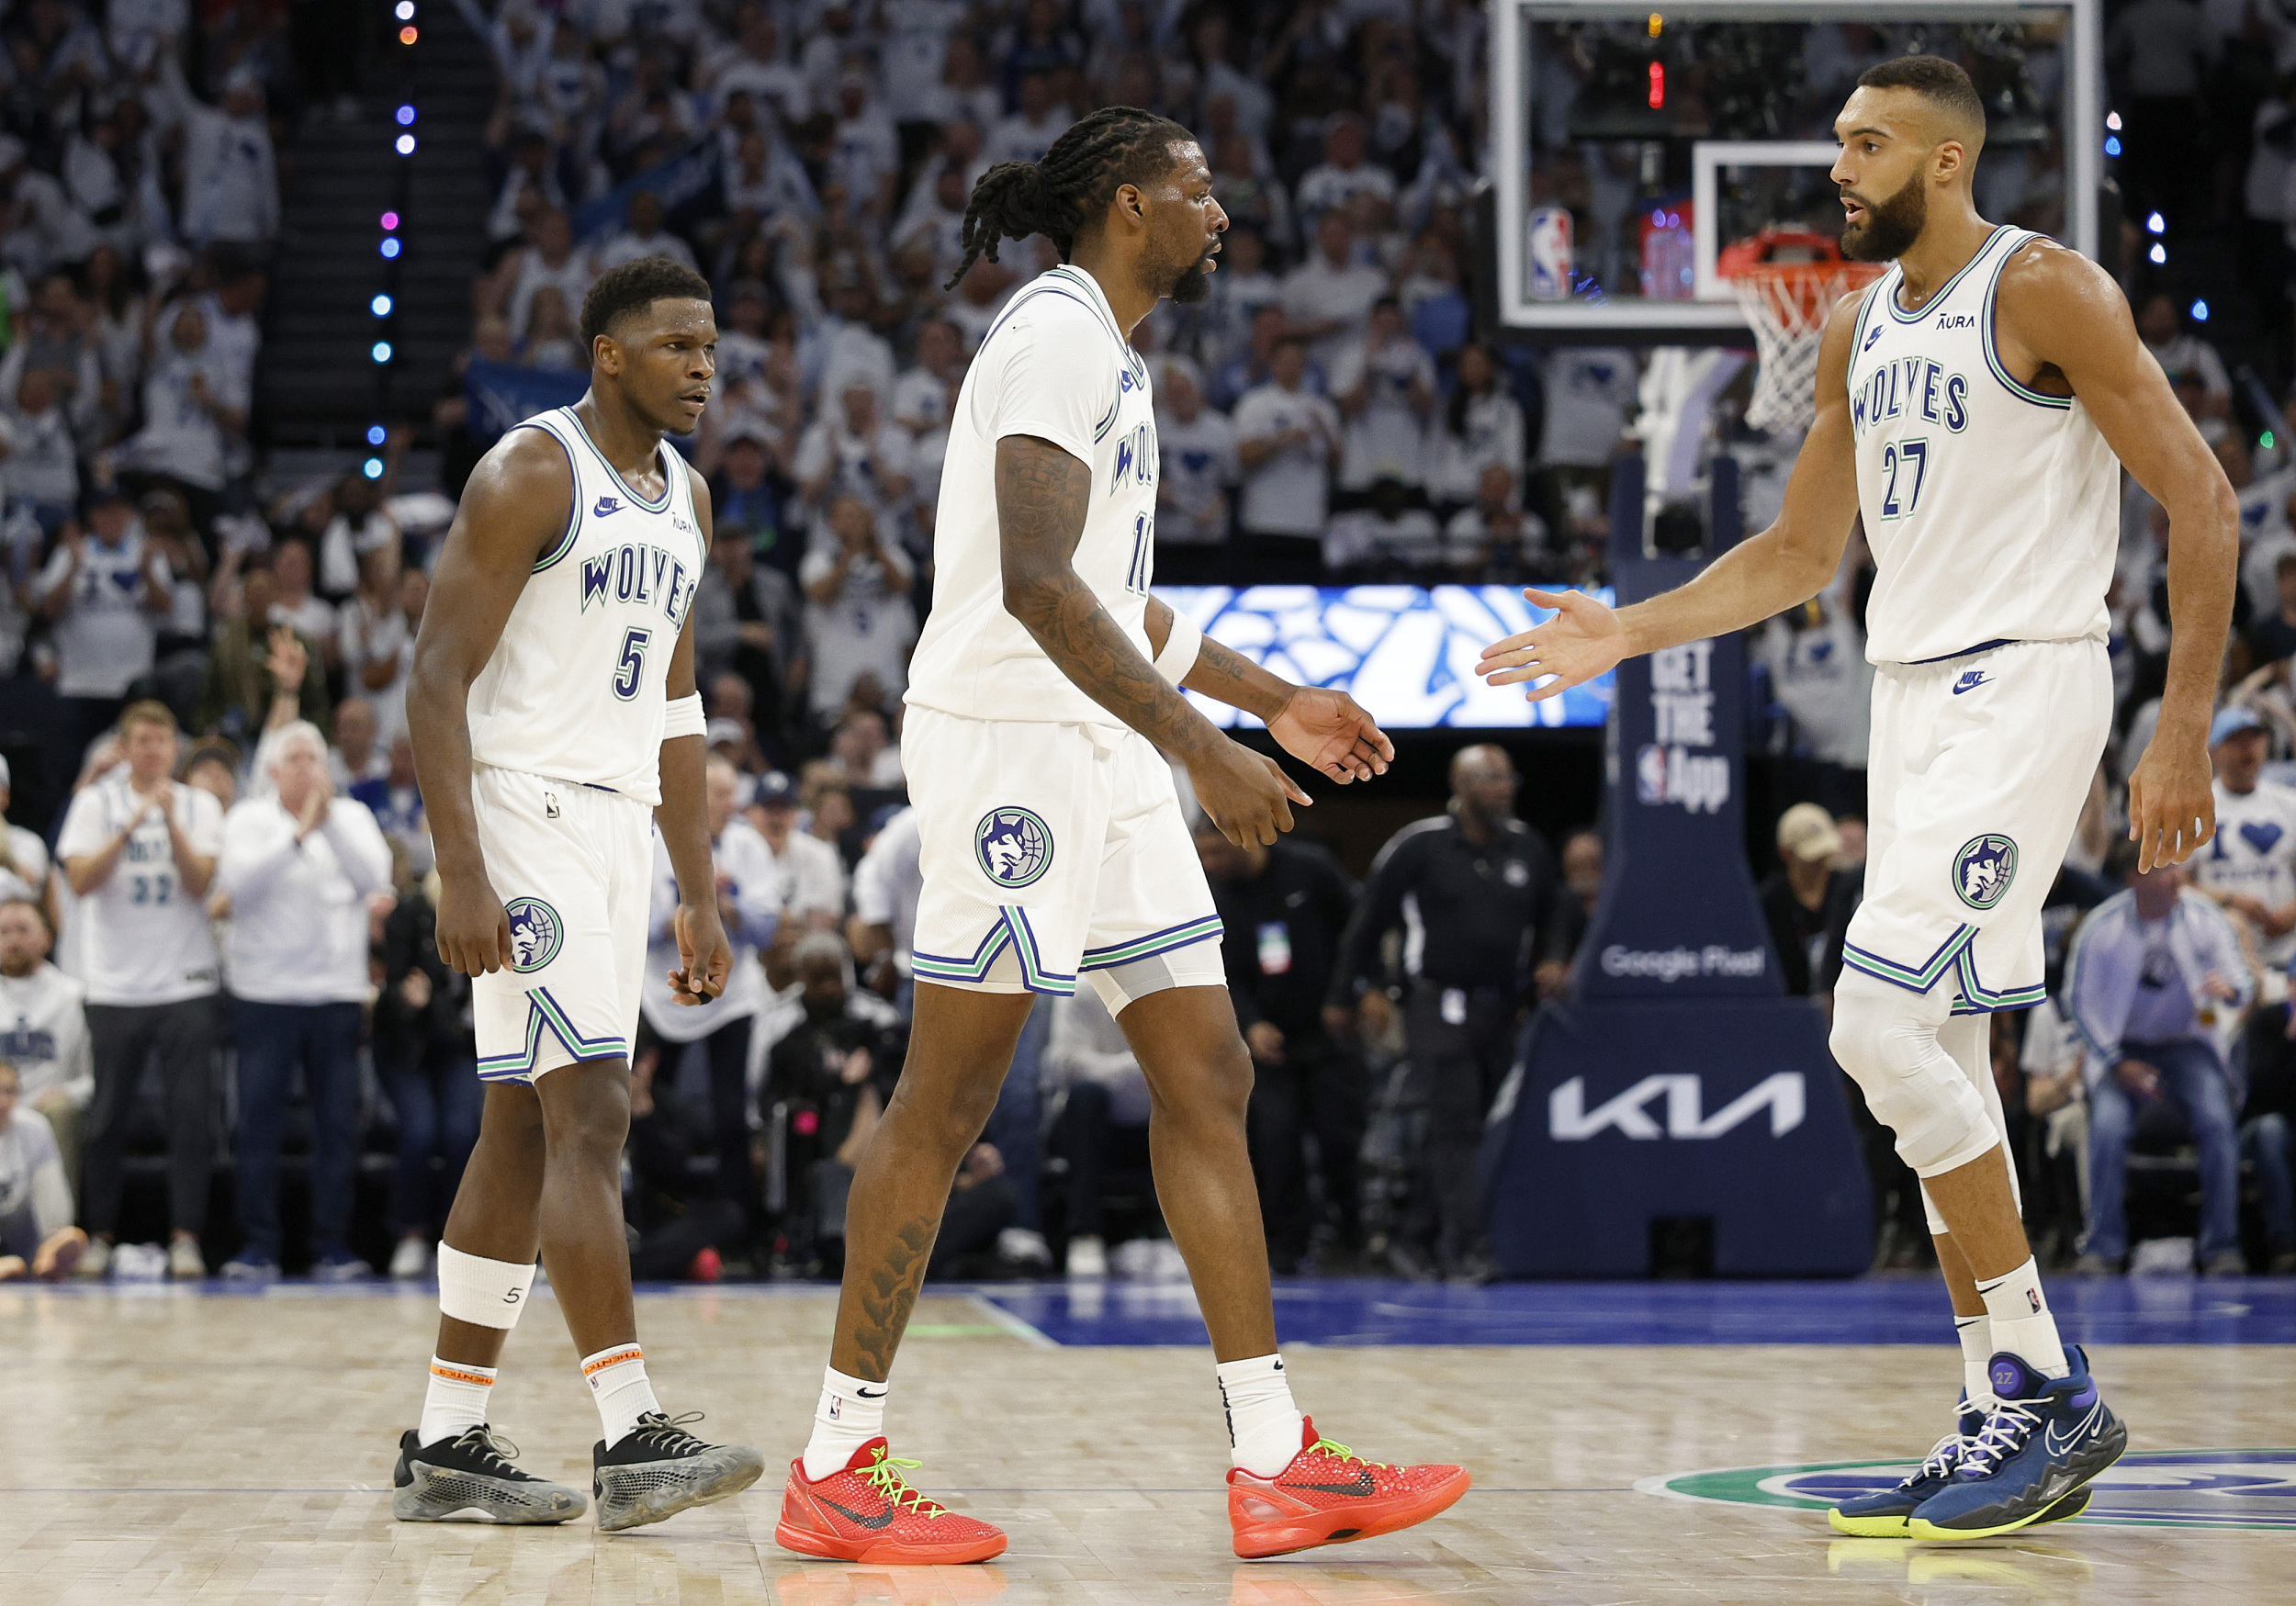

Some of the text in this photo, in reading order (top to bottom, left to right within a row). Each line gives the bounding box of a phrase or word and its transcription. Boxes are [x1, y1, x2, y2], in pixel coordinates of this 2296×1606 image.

[1851, 356, 1968, 449] WOLVES
[1881, 437, 1929, 522] 27
[580, 543, 696, 635] WOLVES
[612, 625, 652, 702] 5
[1650, 638, 1716, 690] GET
[1650, 692, 1716, 746] THE
[1602, 944, 1765, 983] Google Pixel
[1548, 1072, 1806, 1141] KIA
[501, 1287, 523, 1304] 5
